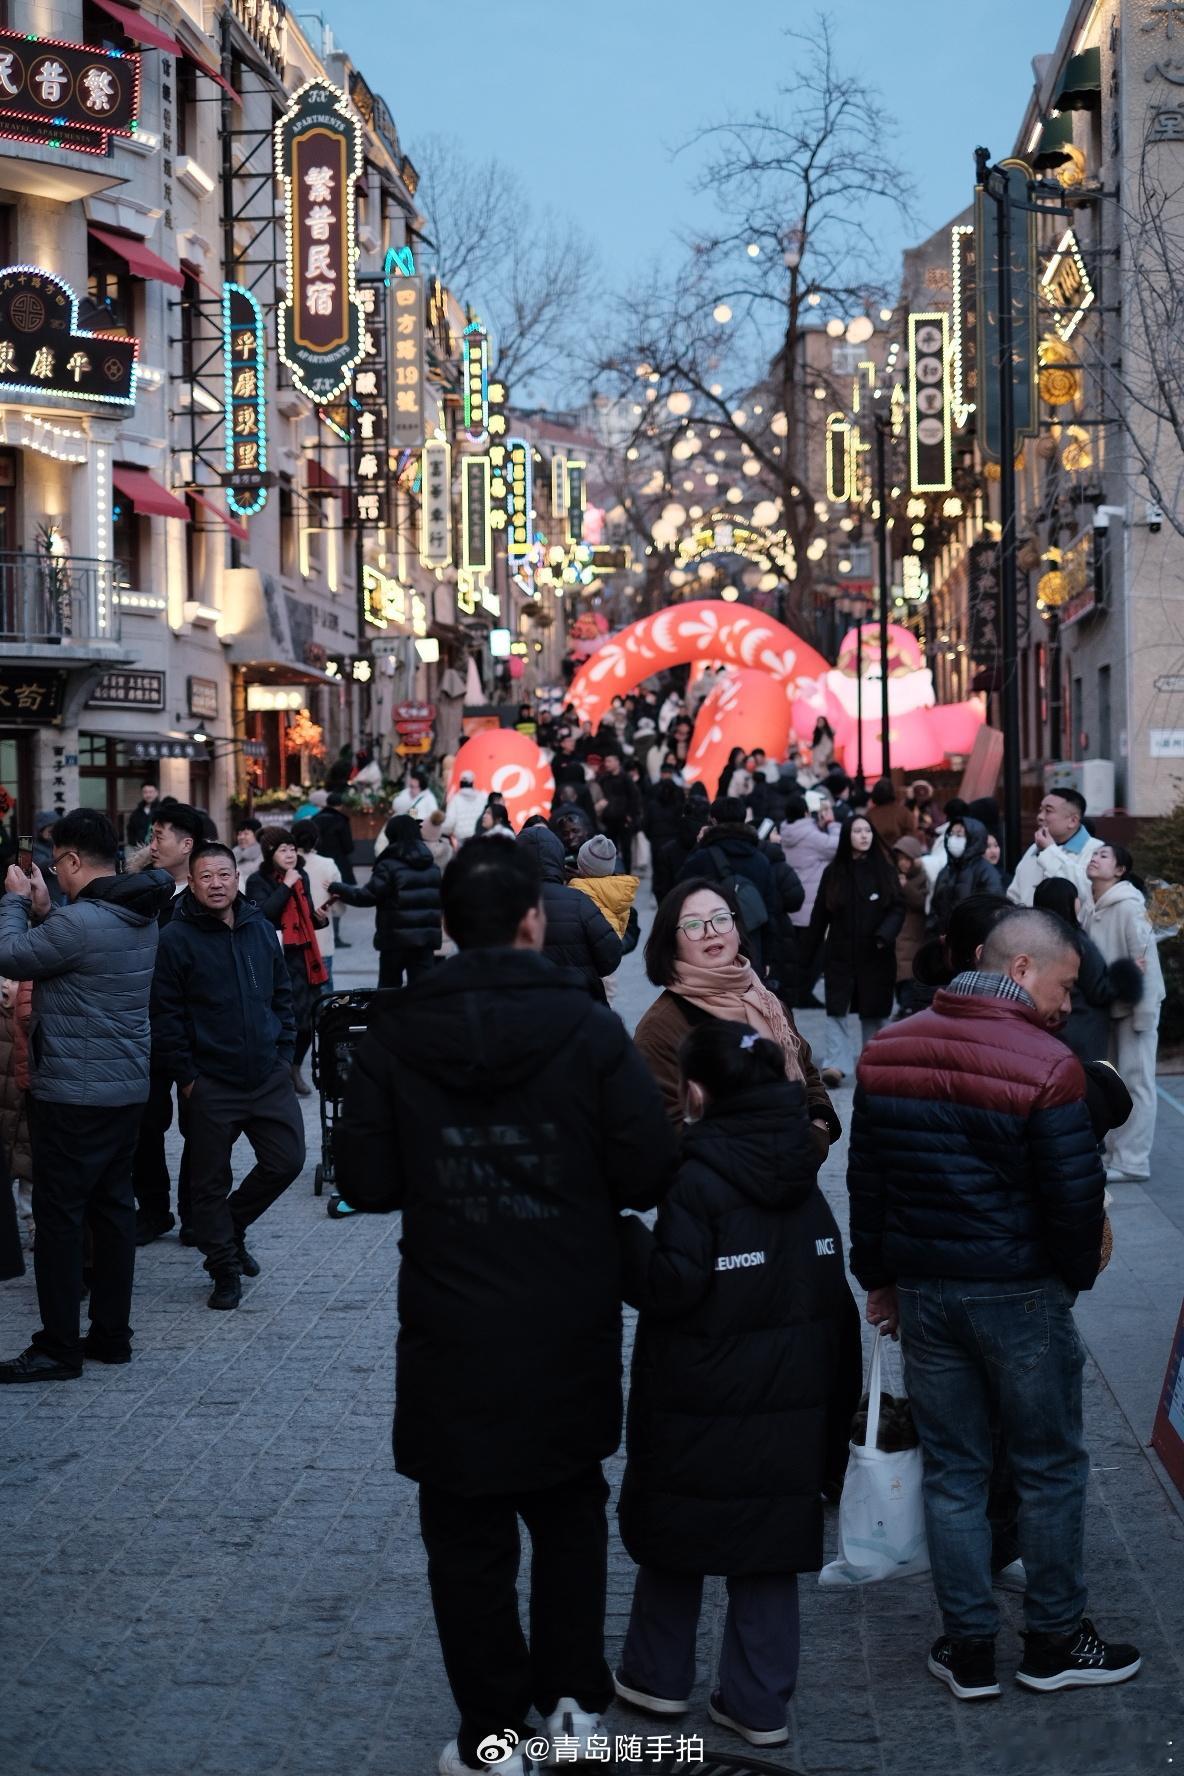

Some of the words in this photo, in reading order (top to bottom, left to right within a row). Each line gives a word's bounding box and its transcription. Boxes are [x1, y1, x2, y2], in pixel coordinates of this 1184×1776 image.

[303, 165, 337, 316] 繁昔民宿
[715, 1250, 765, 1270] EUYOSN
